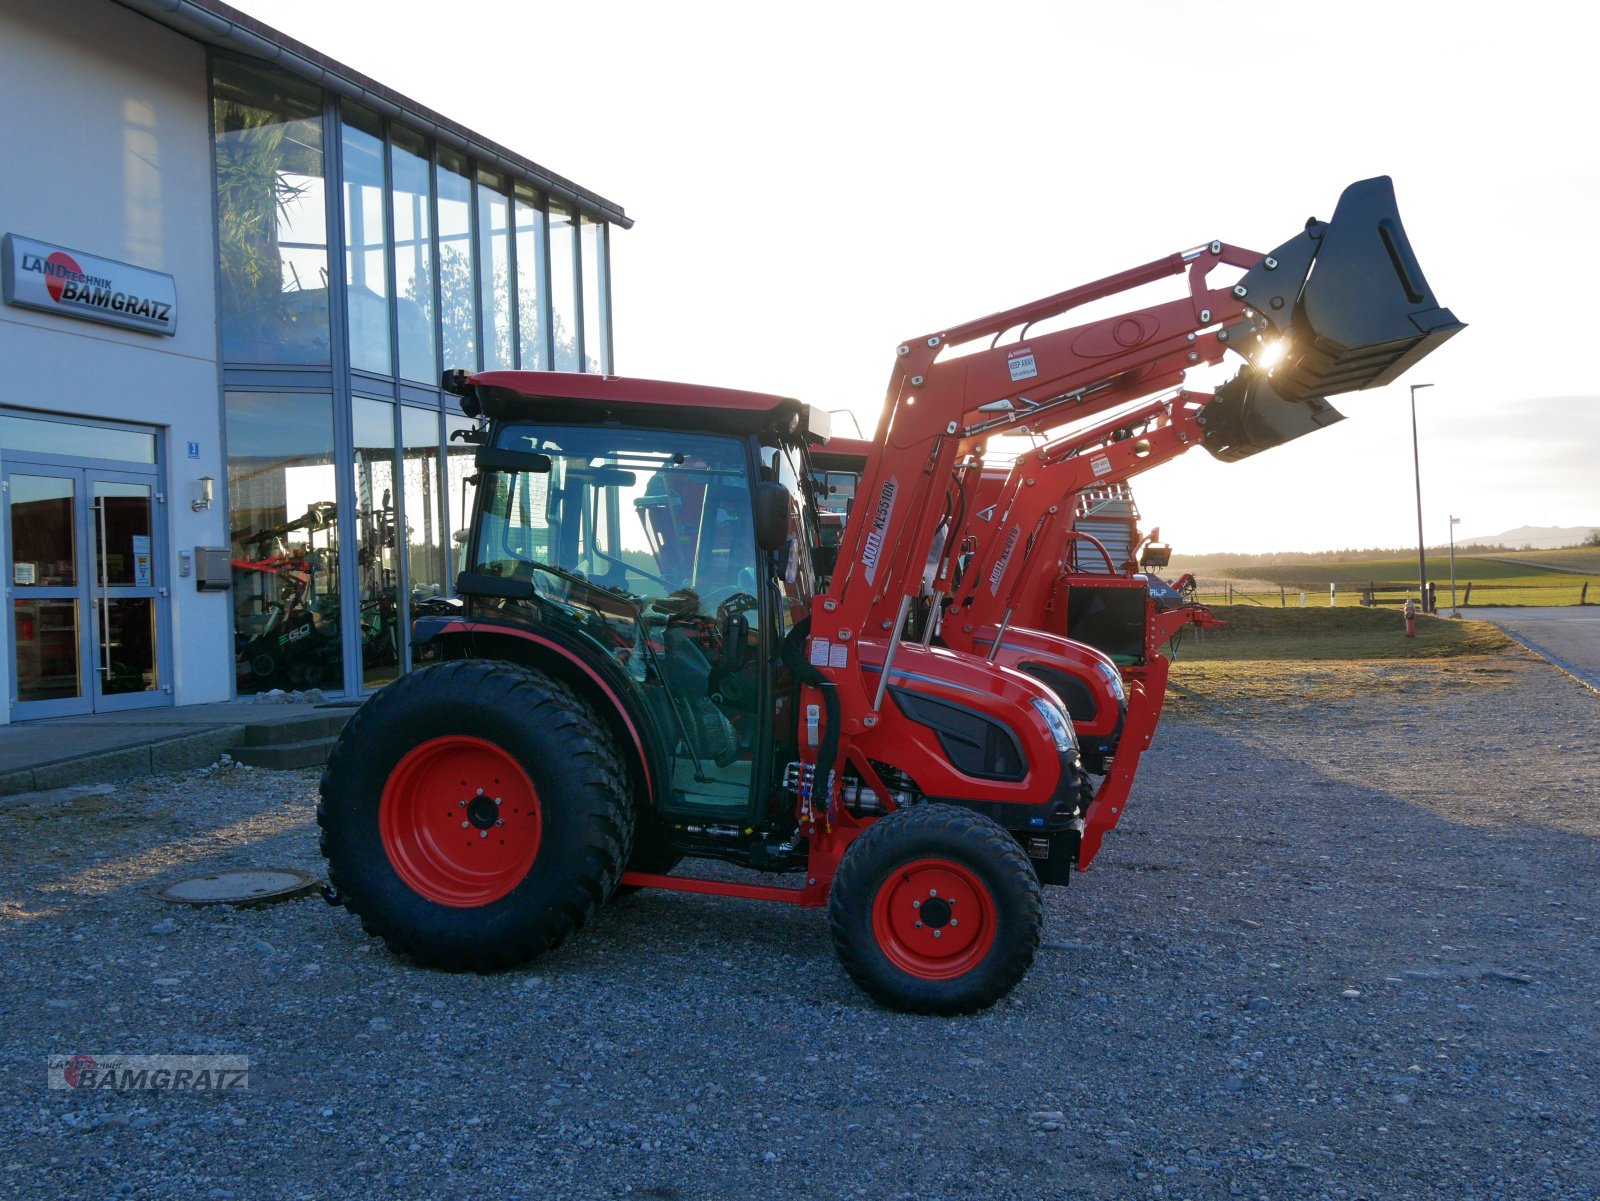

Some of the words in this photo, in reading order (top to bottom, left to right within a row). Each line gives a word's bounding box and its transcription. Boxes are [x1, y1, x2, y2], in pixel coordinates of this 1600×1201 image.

[61, 281, 172, 322] BAMGRATZ
[1010, 361, 1020, 369] KEEP
[1022, 358, 1033, 366] AWAY
[191, 443, 196, 454] 3
[862, 531, 882, 569] KIOTI
[873, 480, 895, 530] KL5510N
[989, 560, 1005, 585] KIOTI
[278, 624, 310, 646] EGO
